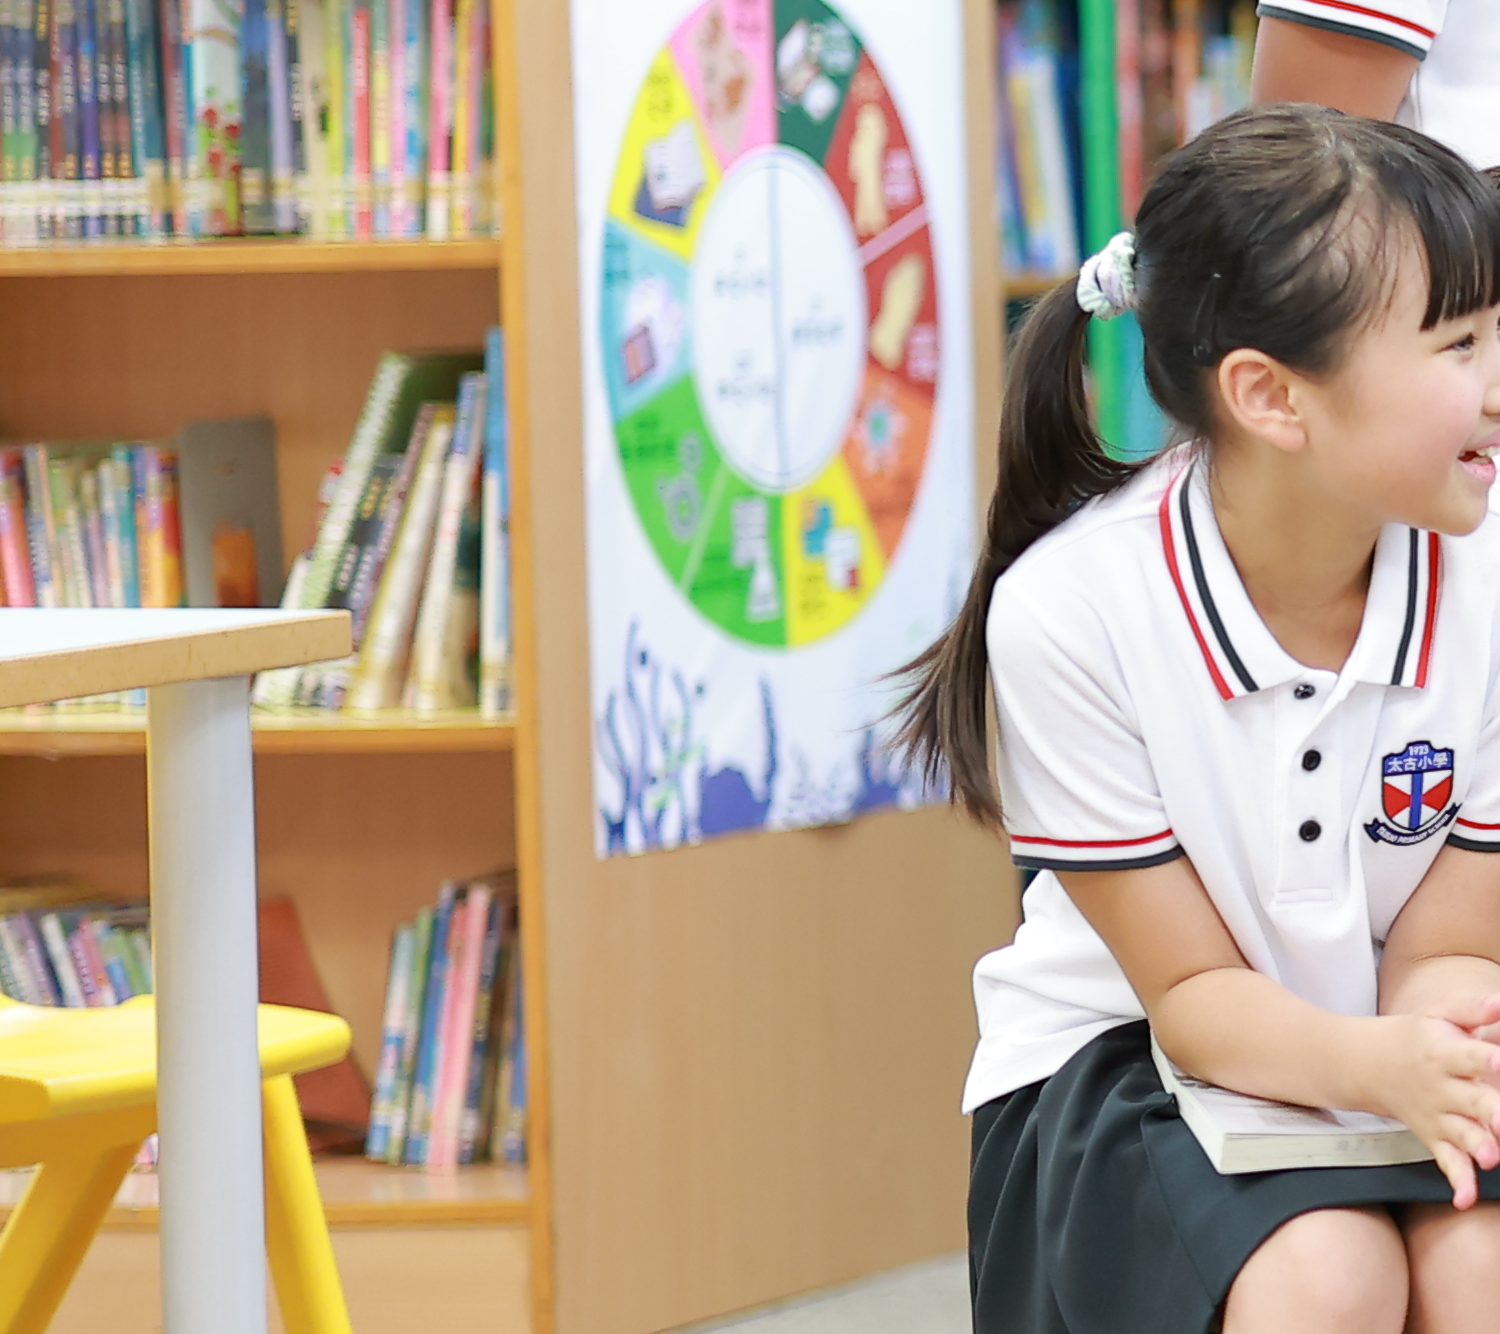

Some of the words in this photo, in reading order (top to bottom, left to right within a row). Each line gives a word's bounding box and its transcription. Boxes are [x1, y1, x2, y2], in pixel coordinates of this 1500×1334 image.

[1408, 744, 1430, 757] 1923
[1387, 751, 1449, 774] 太古小學
